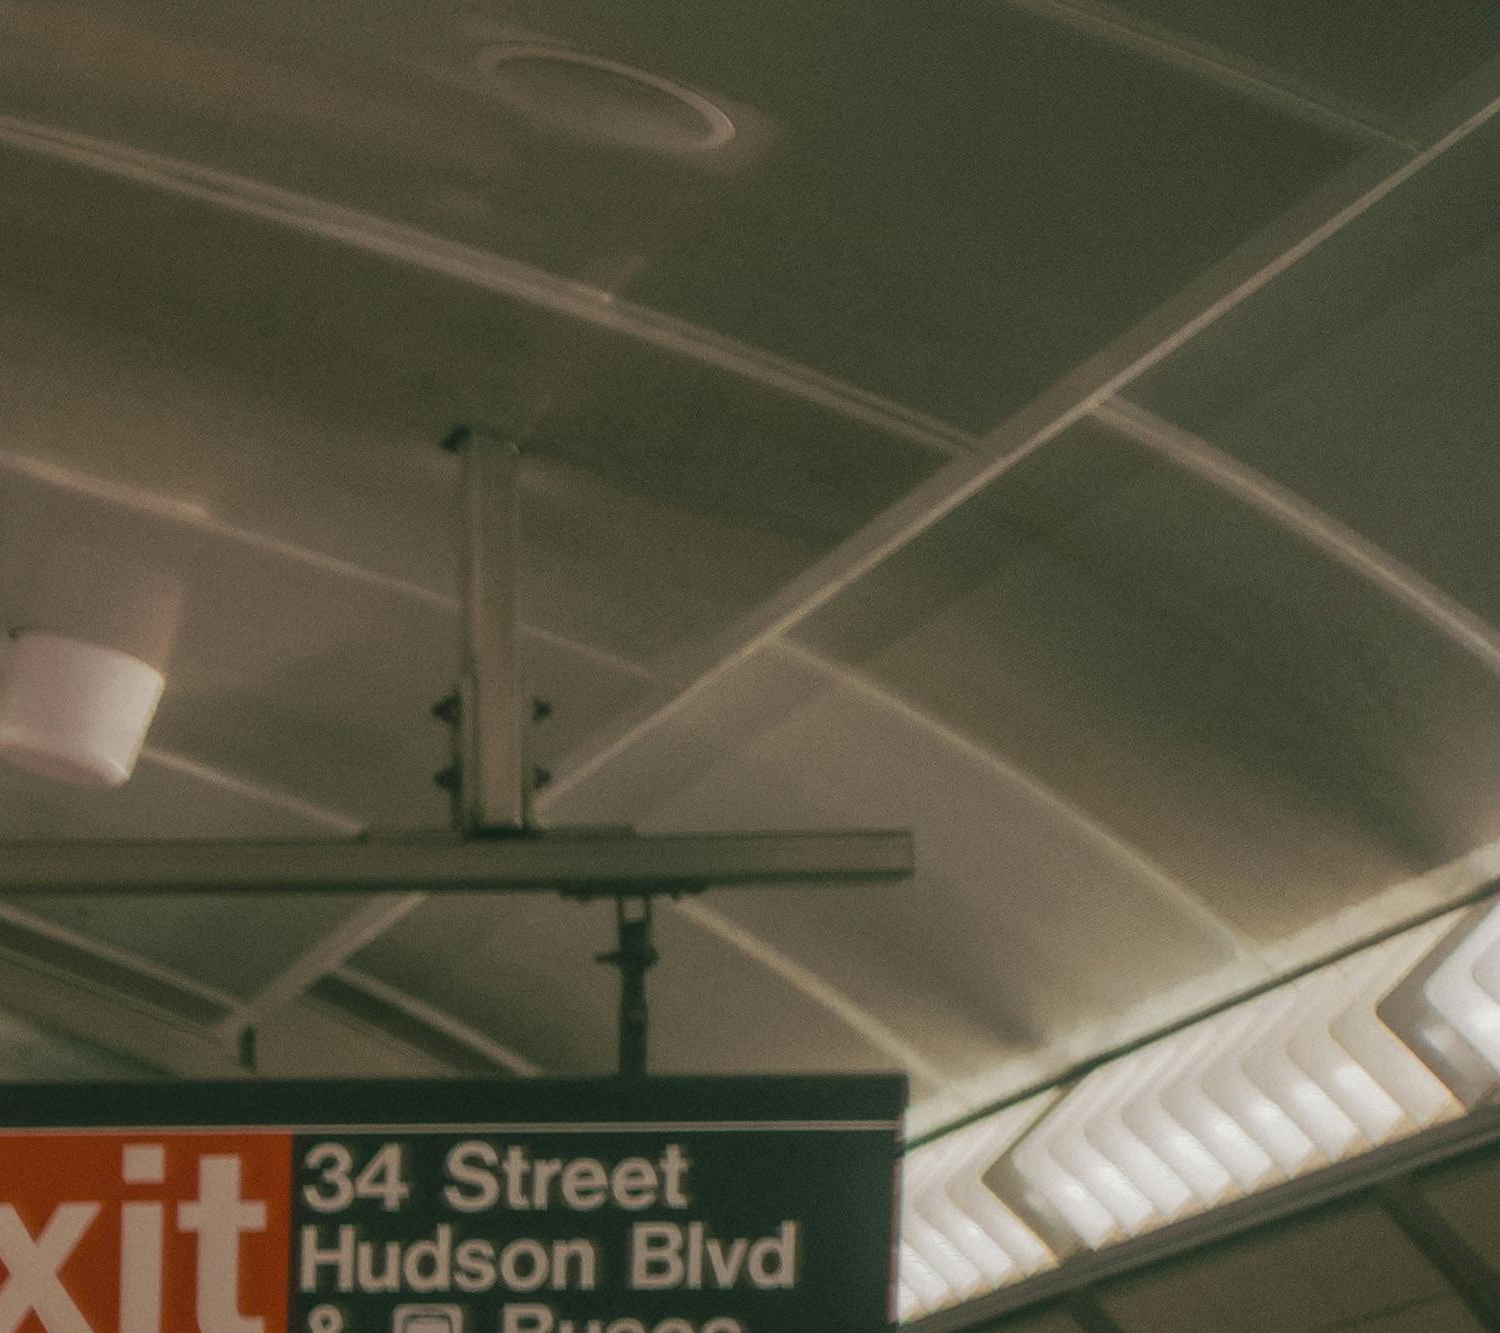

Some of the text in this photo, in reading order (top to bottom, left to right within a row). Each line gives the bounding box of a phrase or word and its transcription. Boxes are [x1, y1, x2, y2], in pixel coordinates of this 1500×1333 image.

[303, 1140, 690, 1213] 34 Street
[300, 1219, 797, 1293] Hudson Blvd
